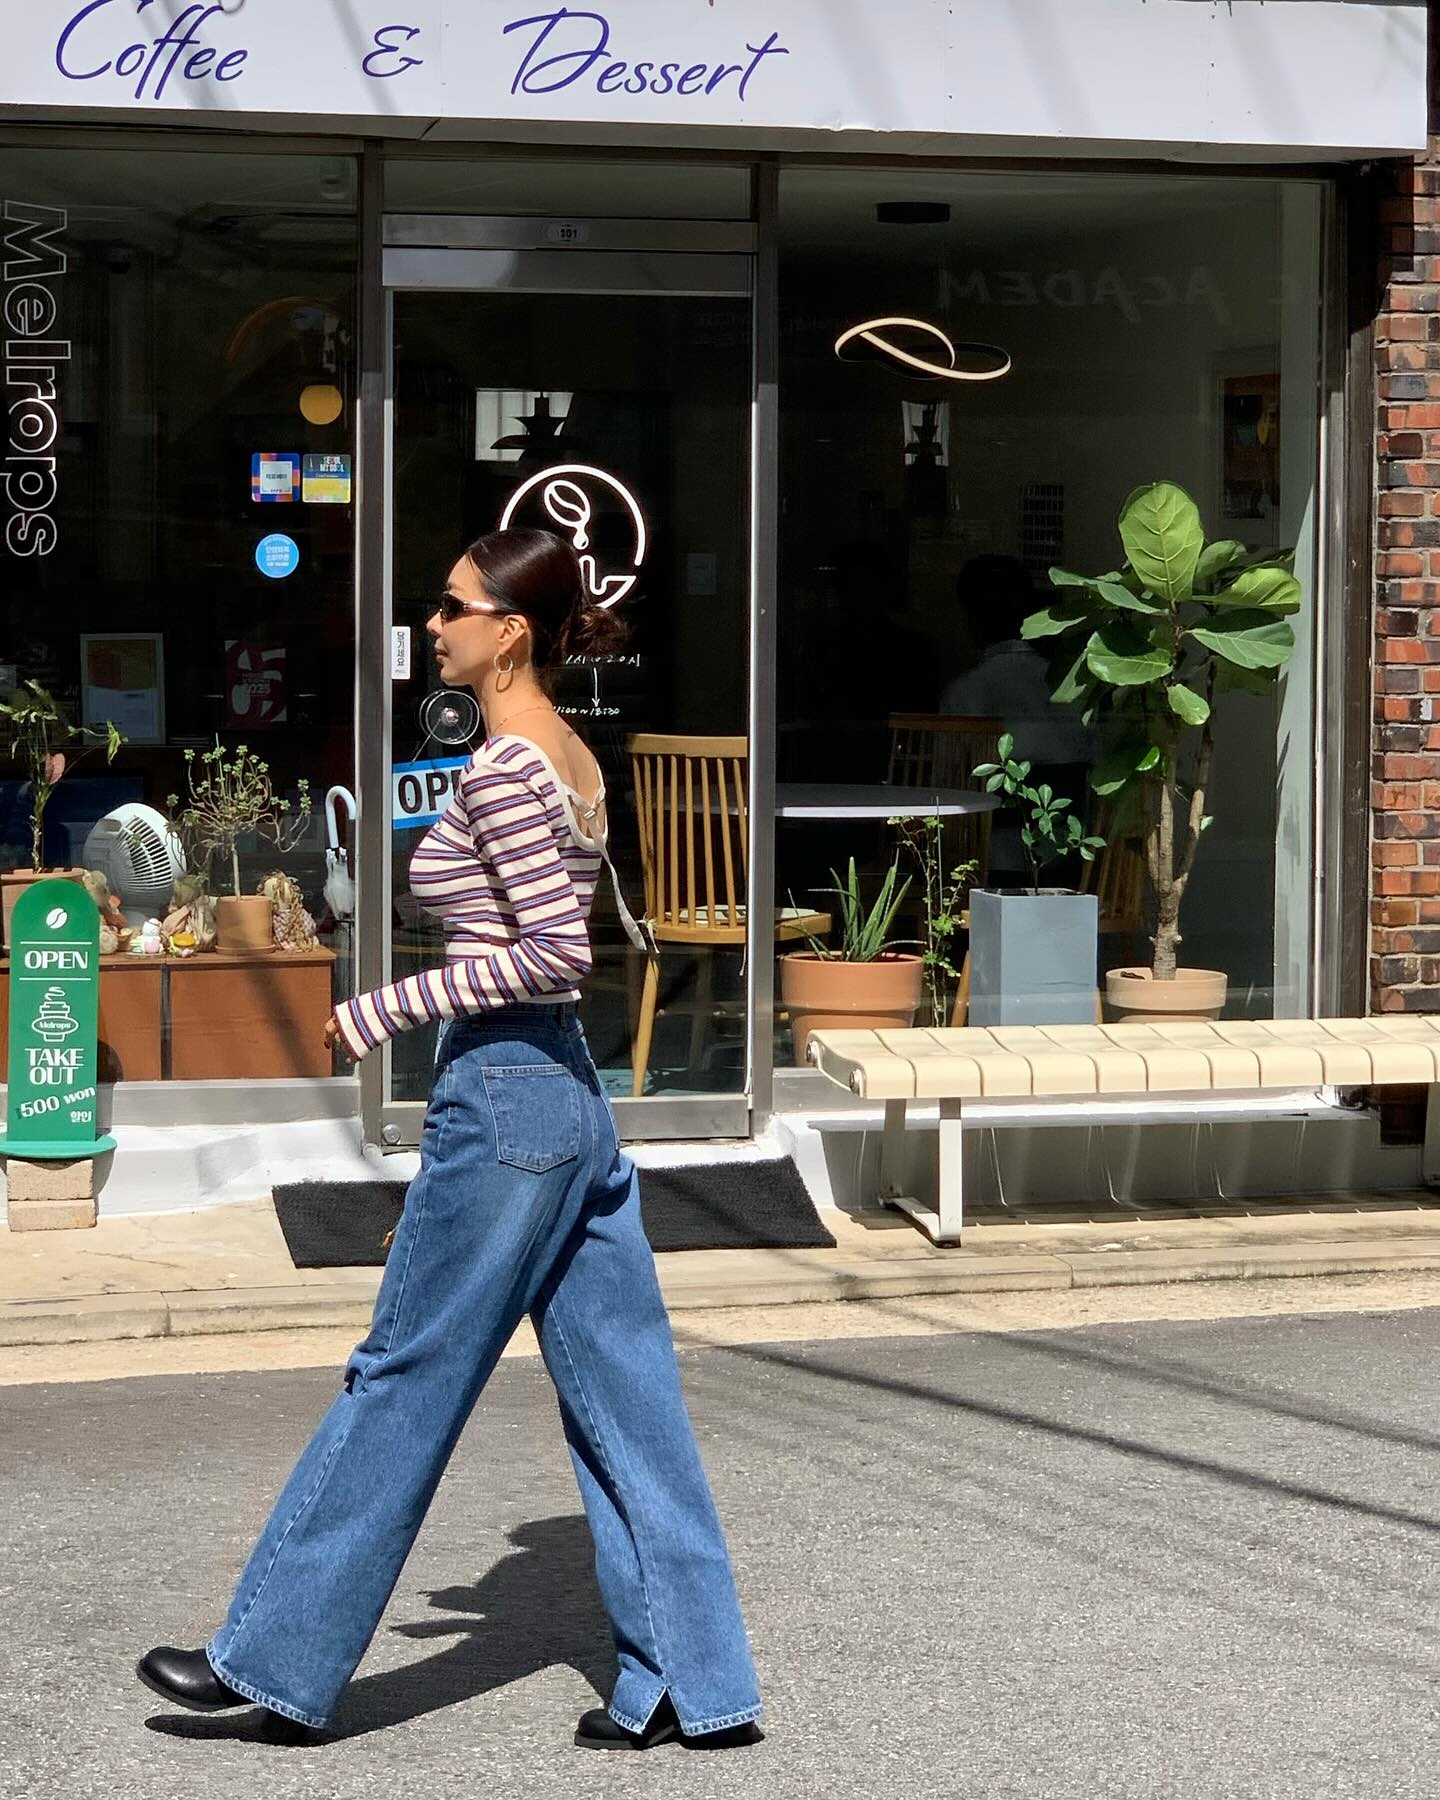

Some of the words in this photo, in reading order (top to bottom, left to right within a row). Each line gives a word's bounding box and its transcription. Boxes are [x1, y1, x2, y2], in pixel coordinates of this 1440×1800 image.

[56, 0, 248, 100] Coffee
[362, 25, 424, 78] &
[503, 7, 789, 101] Dessert
[0, 199, 72, 557] Melrops
[396, 631, 405, 666] 당기세요
[24, 950, 88, 970] OPEN
[24, 1047, 85, 1067] TAKE
[29, 1066, 79, 1086] OUT
[20, 1095, 60, 1118] 500
[63, 1086, 97, 1105] won
